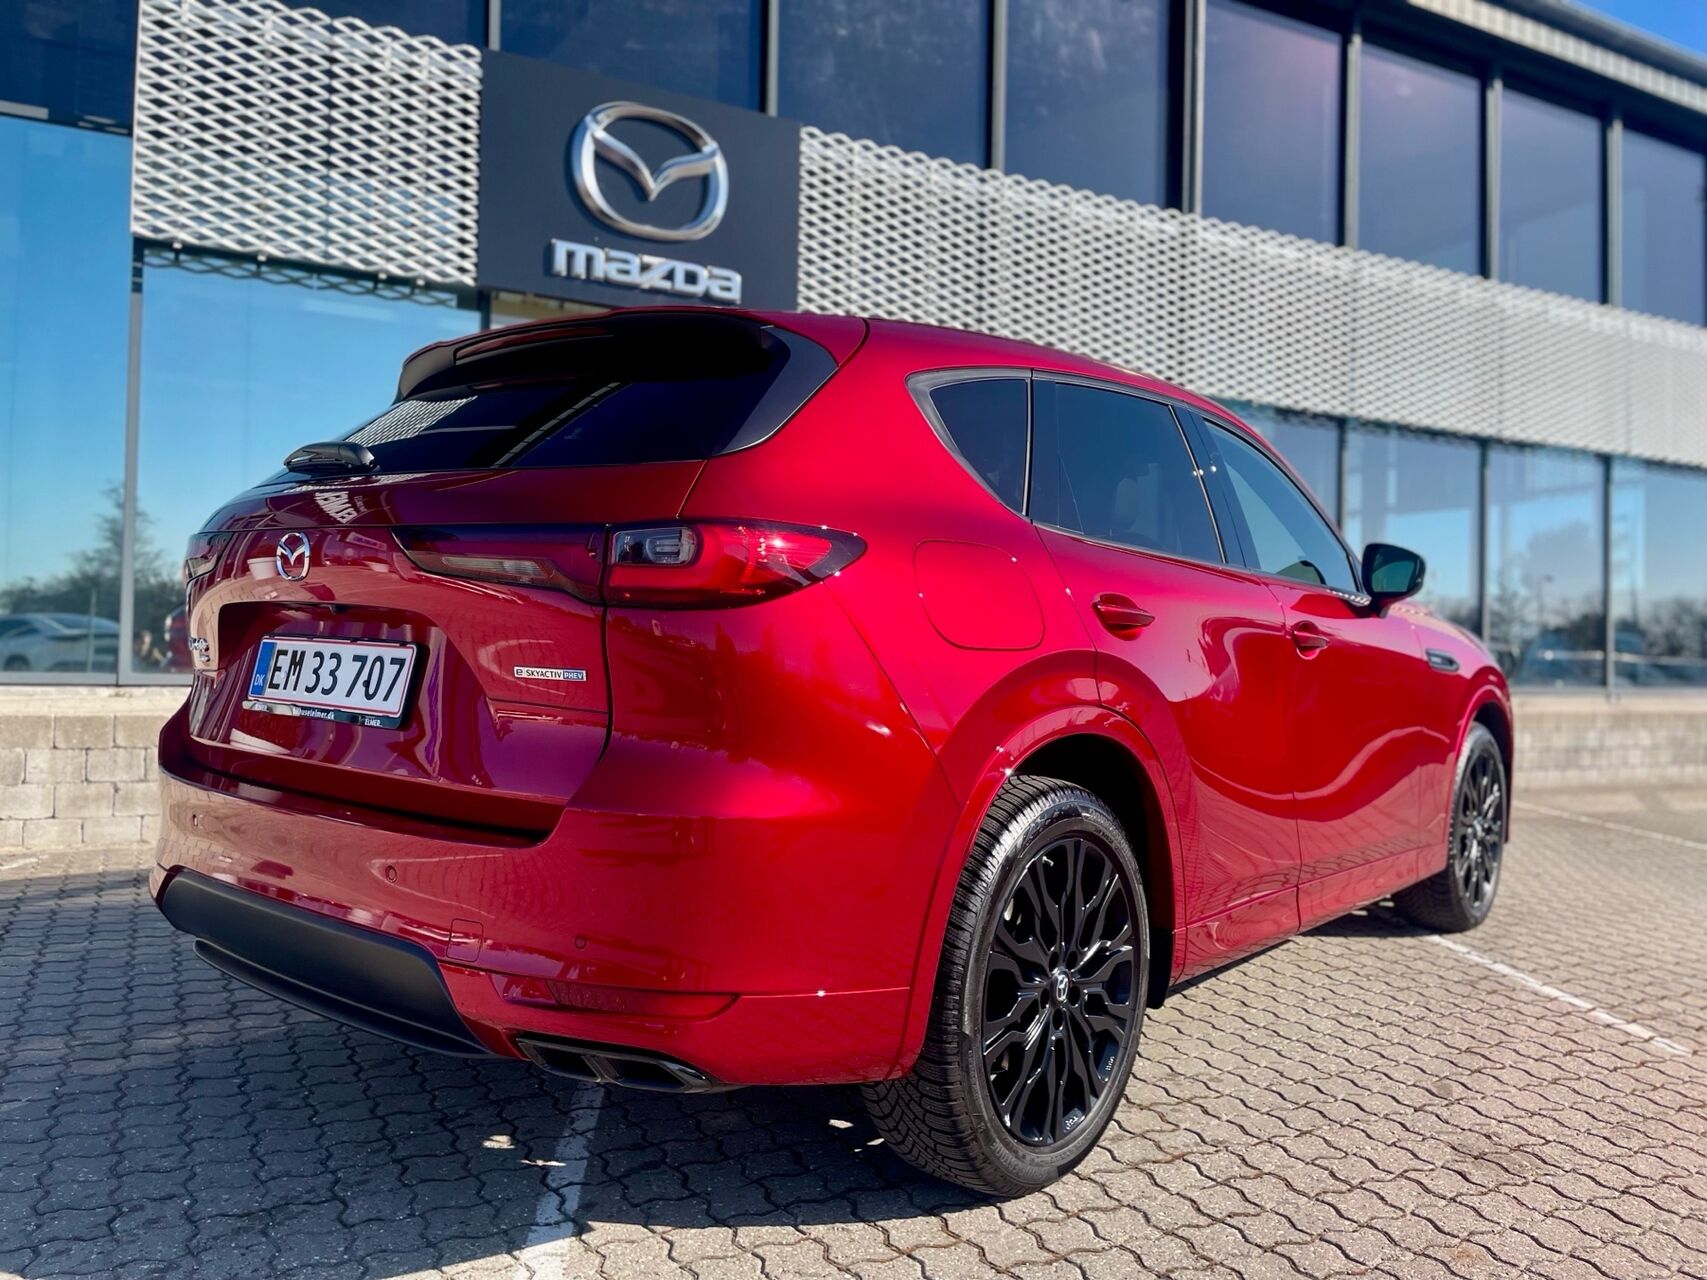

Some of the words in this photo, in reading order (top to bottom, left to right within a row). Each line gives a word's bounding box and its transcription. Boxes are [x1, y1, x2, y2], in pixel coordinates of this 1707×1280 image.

[253, 673, 266, 687] DK
[268, 650, 306, 691] EM
[304, 651, 342, 695] 33
[345, 654, 407, 702] 707
[525, 670, 562, 679] SKYACTIV
